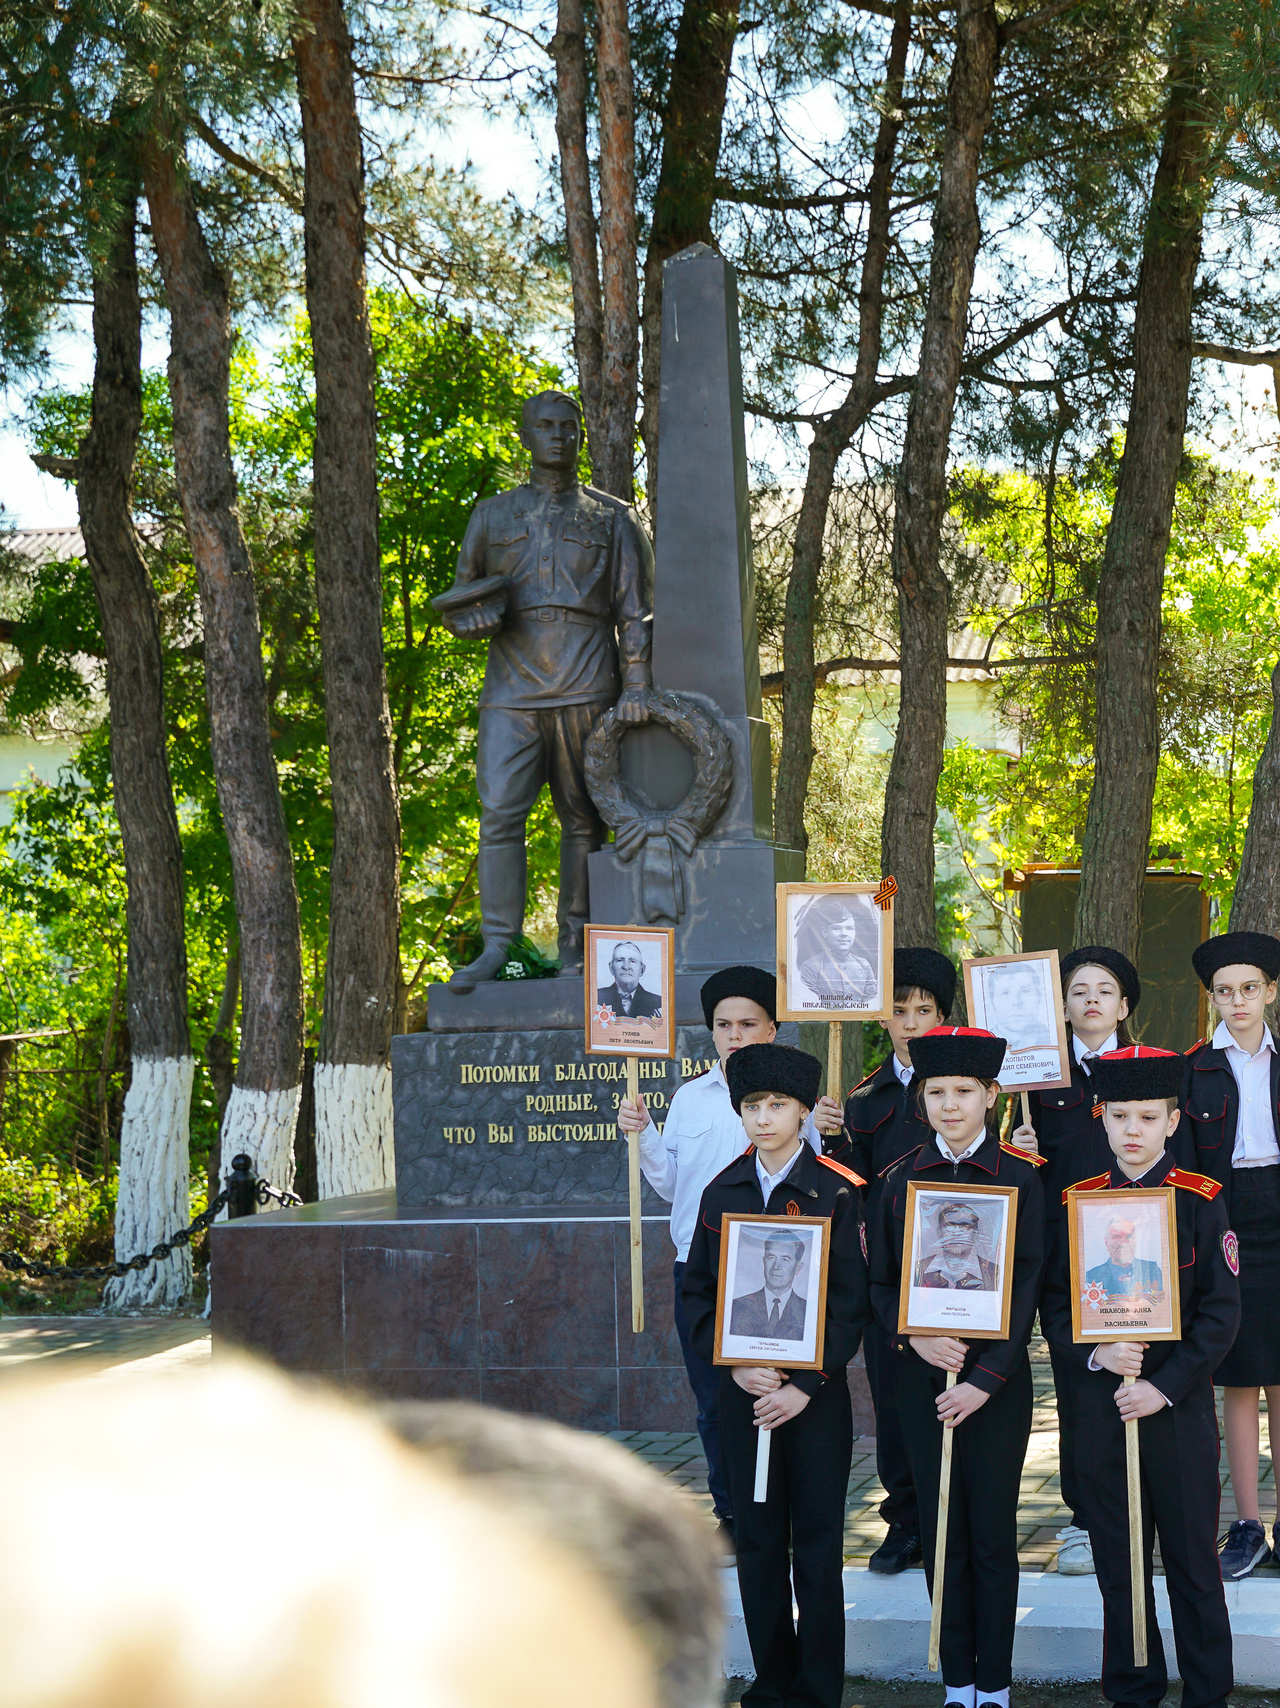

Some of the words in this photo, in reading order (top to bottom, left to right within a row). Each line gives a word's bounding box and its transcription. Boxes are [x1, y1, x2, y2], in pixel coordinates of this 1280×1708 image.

[1005, 1055, 1036, 1063] КОПЫТОВ
[1015, 1061, 1055, 1070] СЕМЕНОВИЧ
[460, 1064, 541, 1084] ПОТОМКИ
[555, 1061, 667, 1083] БЛАГОДАНЫ
[526, 1093, 598, 1115] РОДНЫЕ,
[443, 1126, 476, 1144] ЧТО
[488, 1123, 514, 1143] ВЫ
[528, 1122, 618, 1142] ВЫСТОЯЛИ
